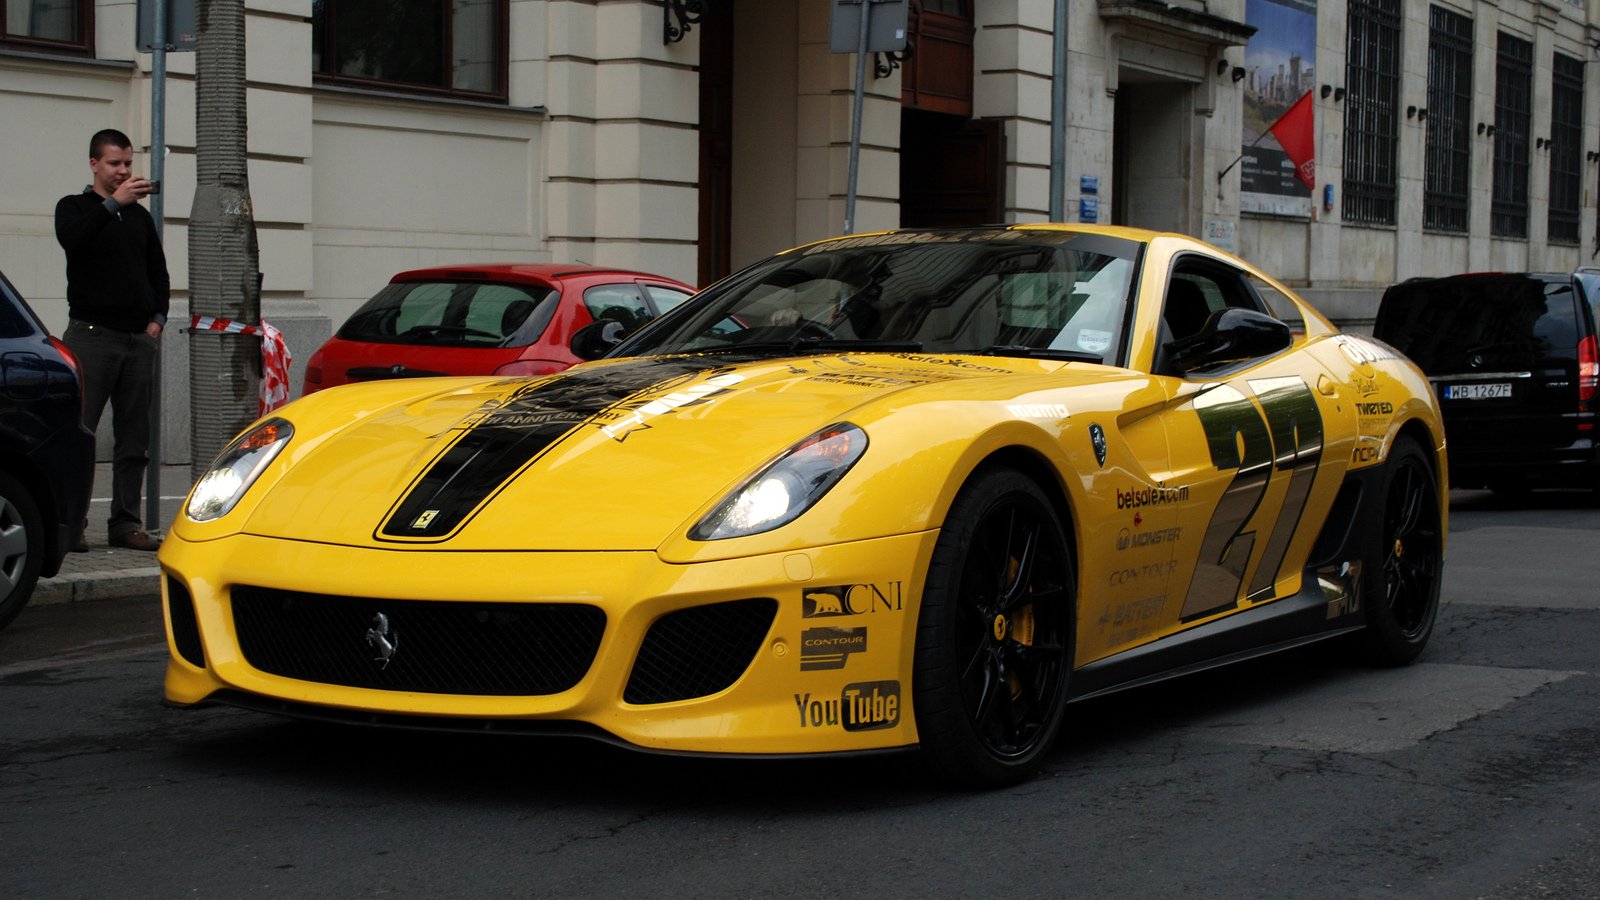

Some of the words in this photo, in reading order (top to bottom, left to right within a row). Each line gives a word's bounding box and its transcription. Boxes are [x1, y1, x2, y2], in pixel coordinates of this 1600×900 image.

[1451, 386, 1469, 397] WB
[1474, 384, 1511, 397] 1267F
[1131, 526, 1183, 549] MONSTER
[845, 581, 903, 615] CNI
[804, 636, 865, 647] CONTOUR
